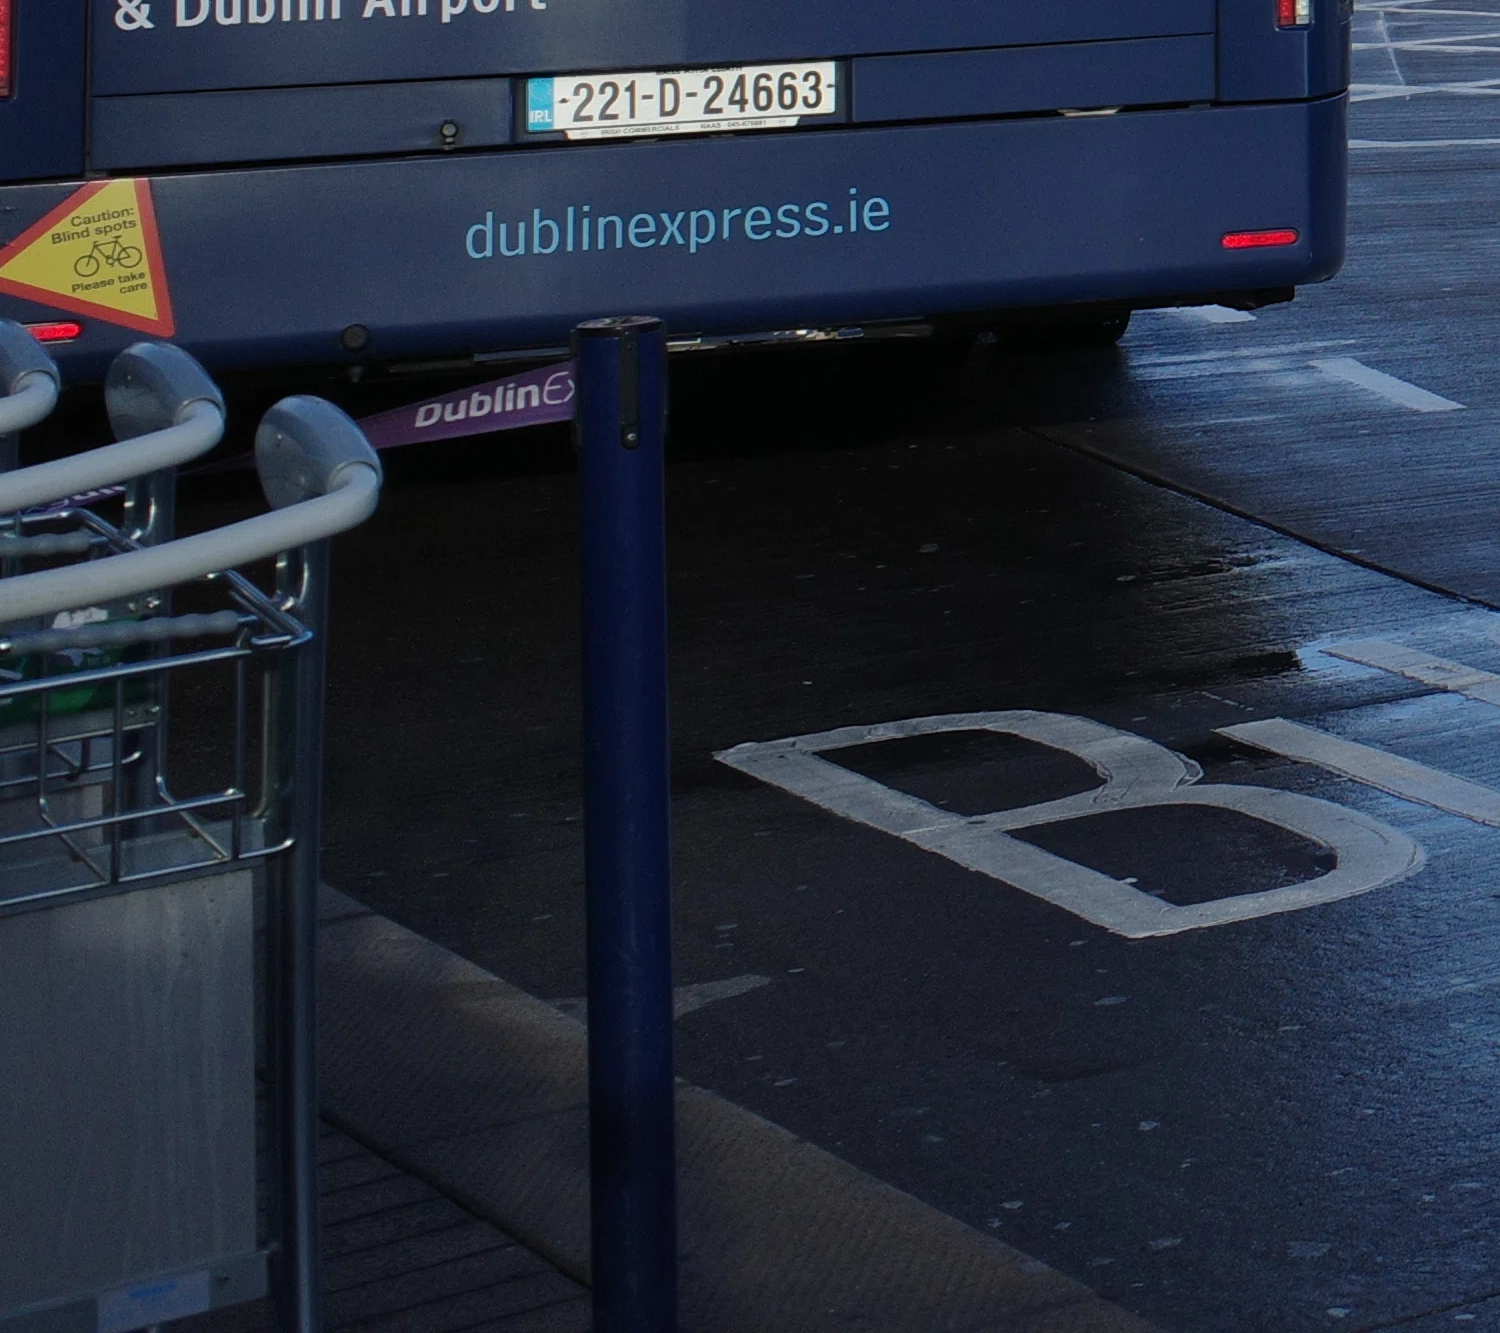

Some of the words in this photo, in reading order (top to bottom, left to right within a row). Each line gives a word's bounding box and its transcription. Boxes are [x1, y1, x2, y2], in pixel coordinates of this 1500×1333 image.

[573, 70, 823, 123] 221-D-24663
[528, 109, 553, 124] IRL
[71, 207, 136, 227] Caution:
[465, 188, 890, 259] dublinexpress.ie
[51, 227, 91, 245] Blind
[94, 219, 137, 237] spots
[71, 278, 115, 294] Please
[117, 271, 146, 284] take
[119, 282, 148, 295] care
